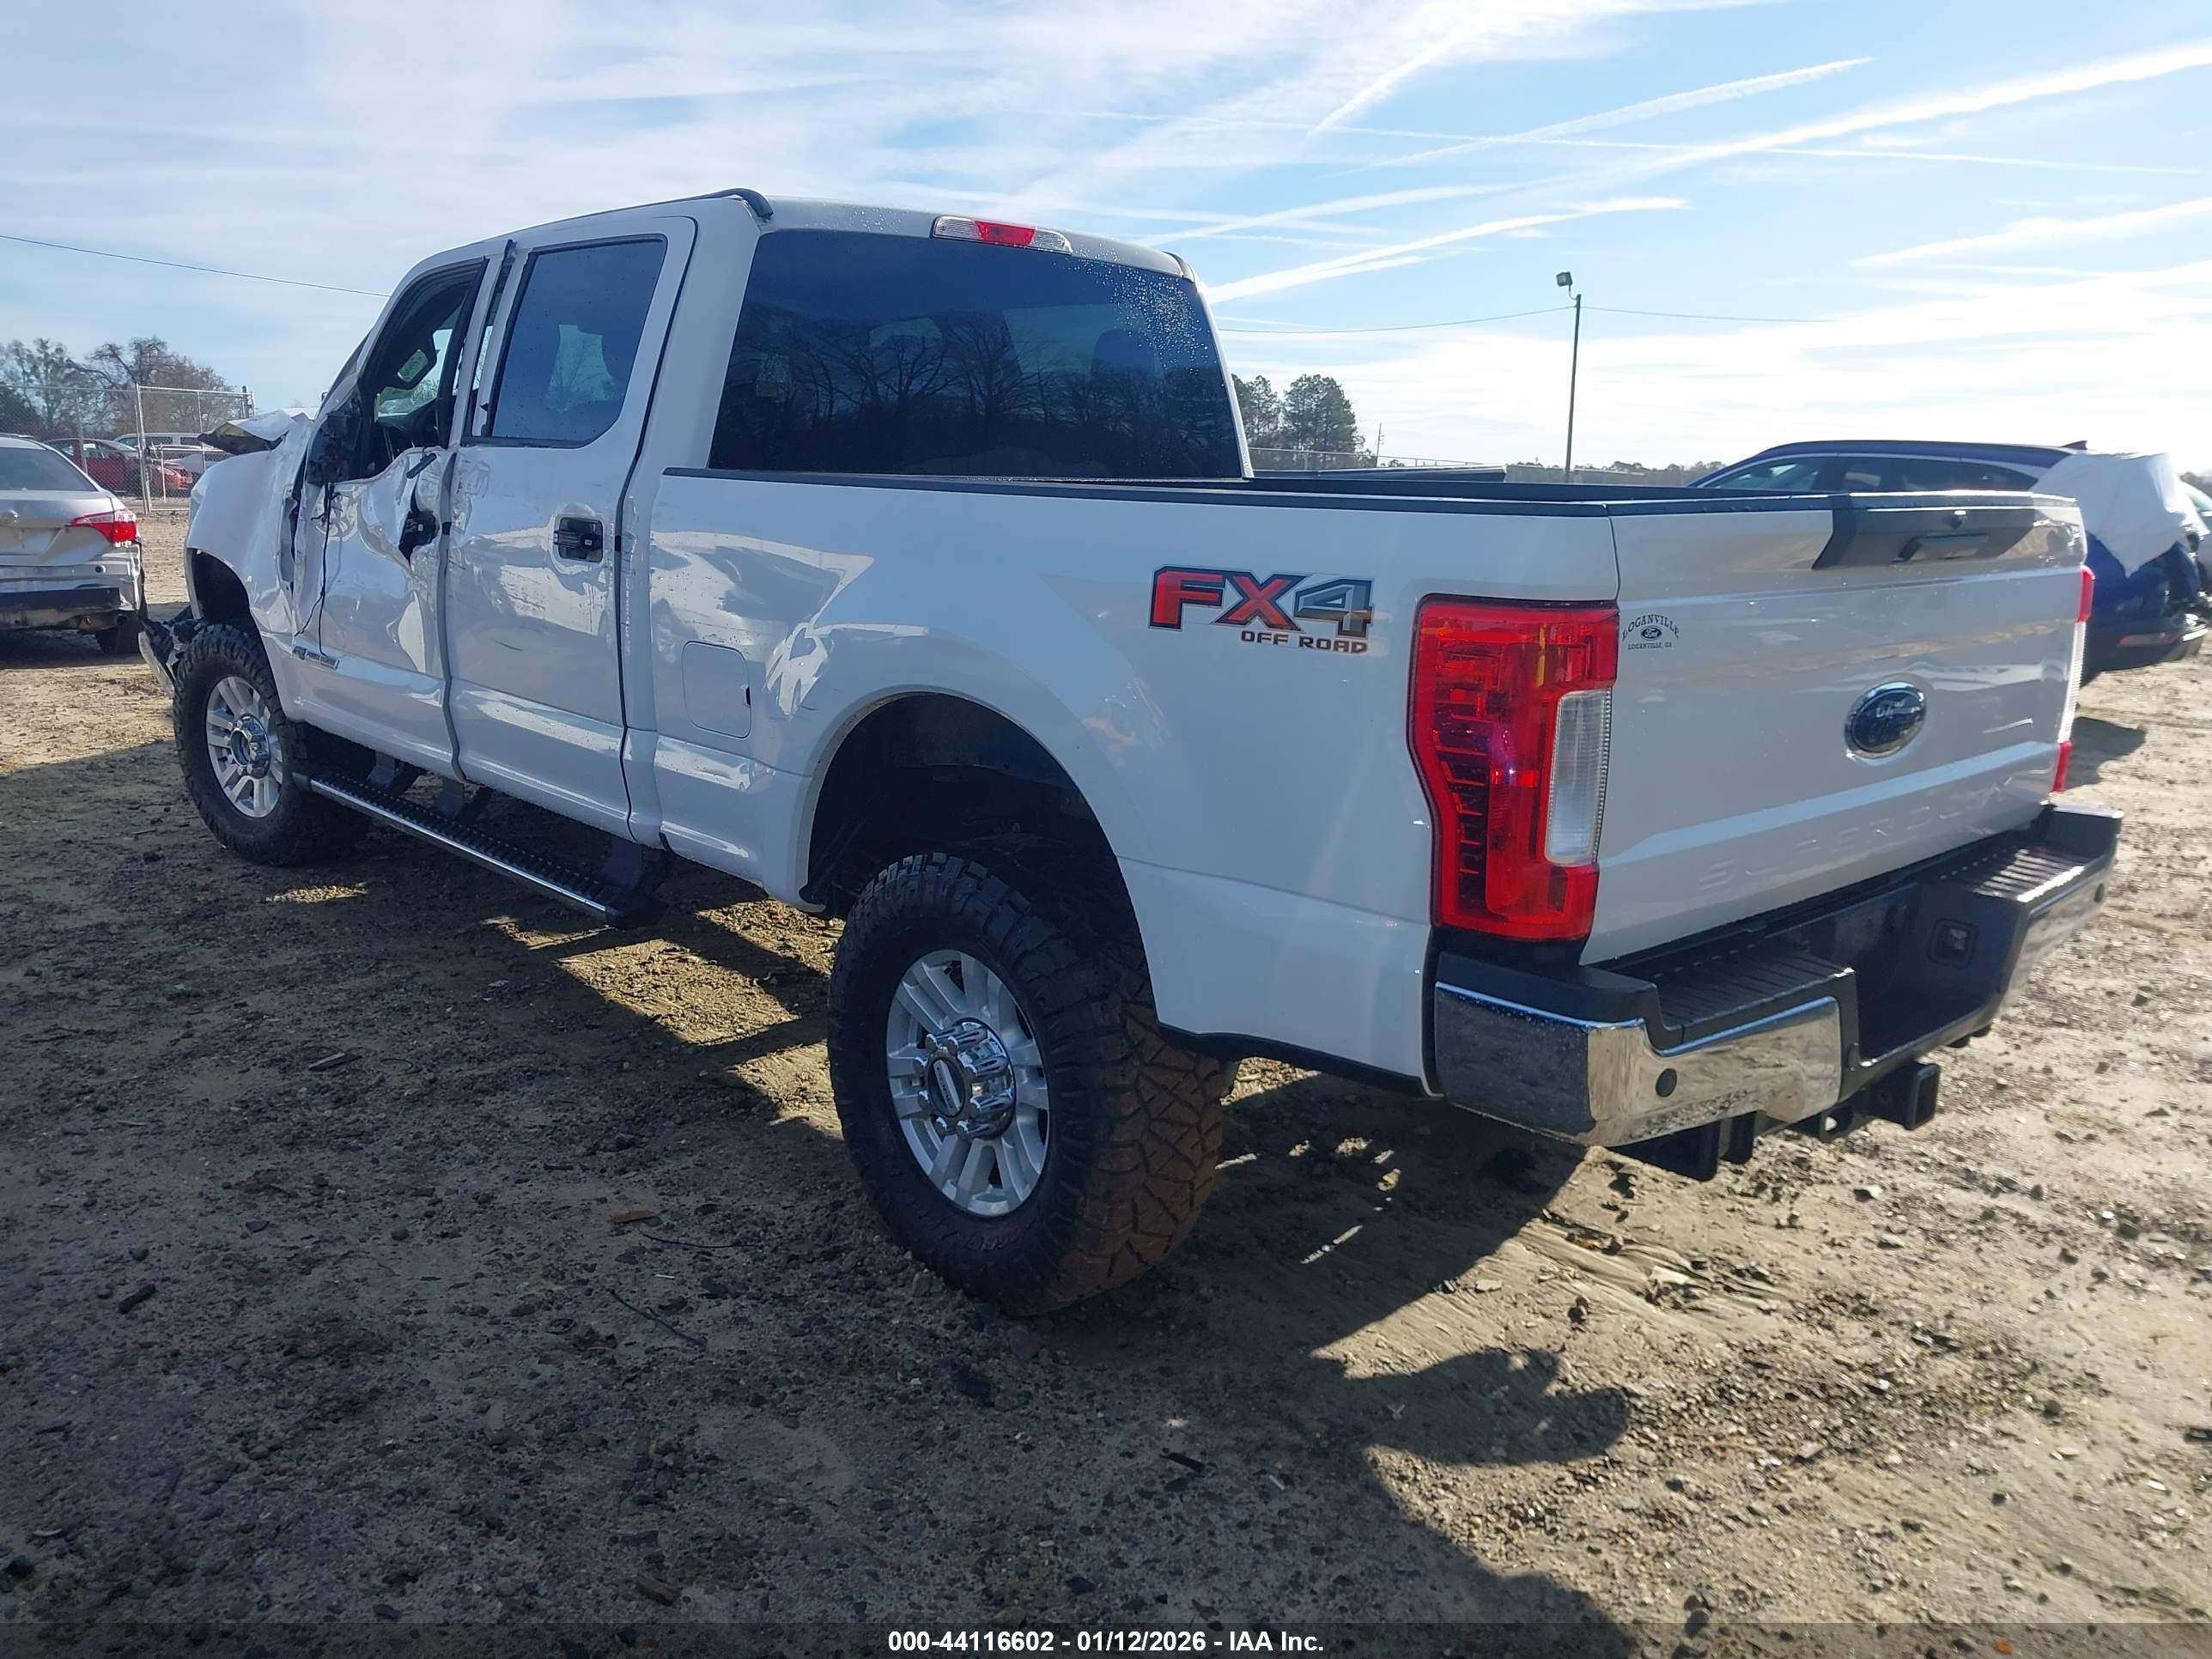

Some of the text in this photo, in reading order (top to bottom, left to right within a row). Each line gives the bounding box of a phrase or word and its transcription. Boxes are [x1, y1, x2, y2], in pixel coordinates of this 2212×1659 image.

[1149, 564, 1374, 639] FX4
[1241, 629, 1368, 653] OFF ROAD
